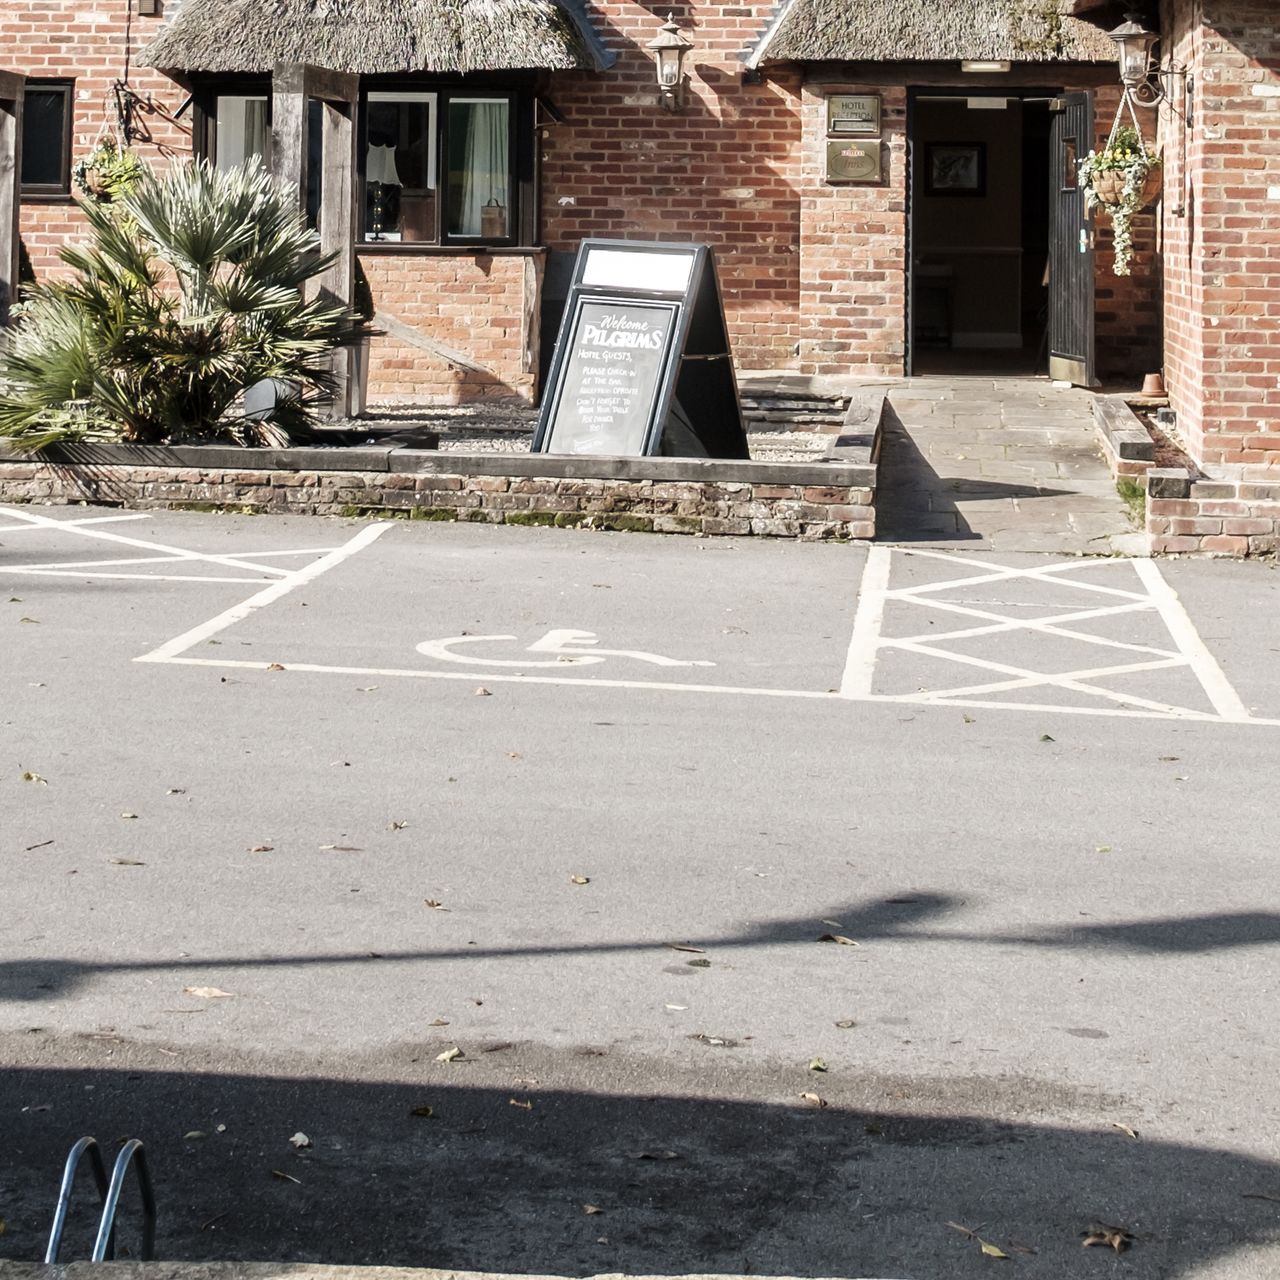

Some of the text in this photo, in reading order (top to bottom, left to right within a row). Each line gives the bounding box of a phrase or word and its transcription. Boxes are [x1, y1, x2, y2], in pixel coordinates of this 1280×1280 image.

[841, 102, 865, 110] HOTEL
[600, 314, 649, 331] Welcome
[581, 324, 663, 350] PILGRIMS
[595, 377, 607, 385] THE
